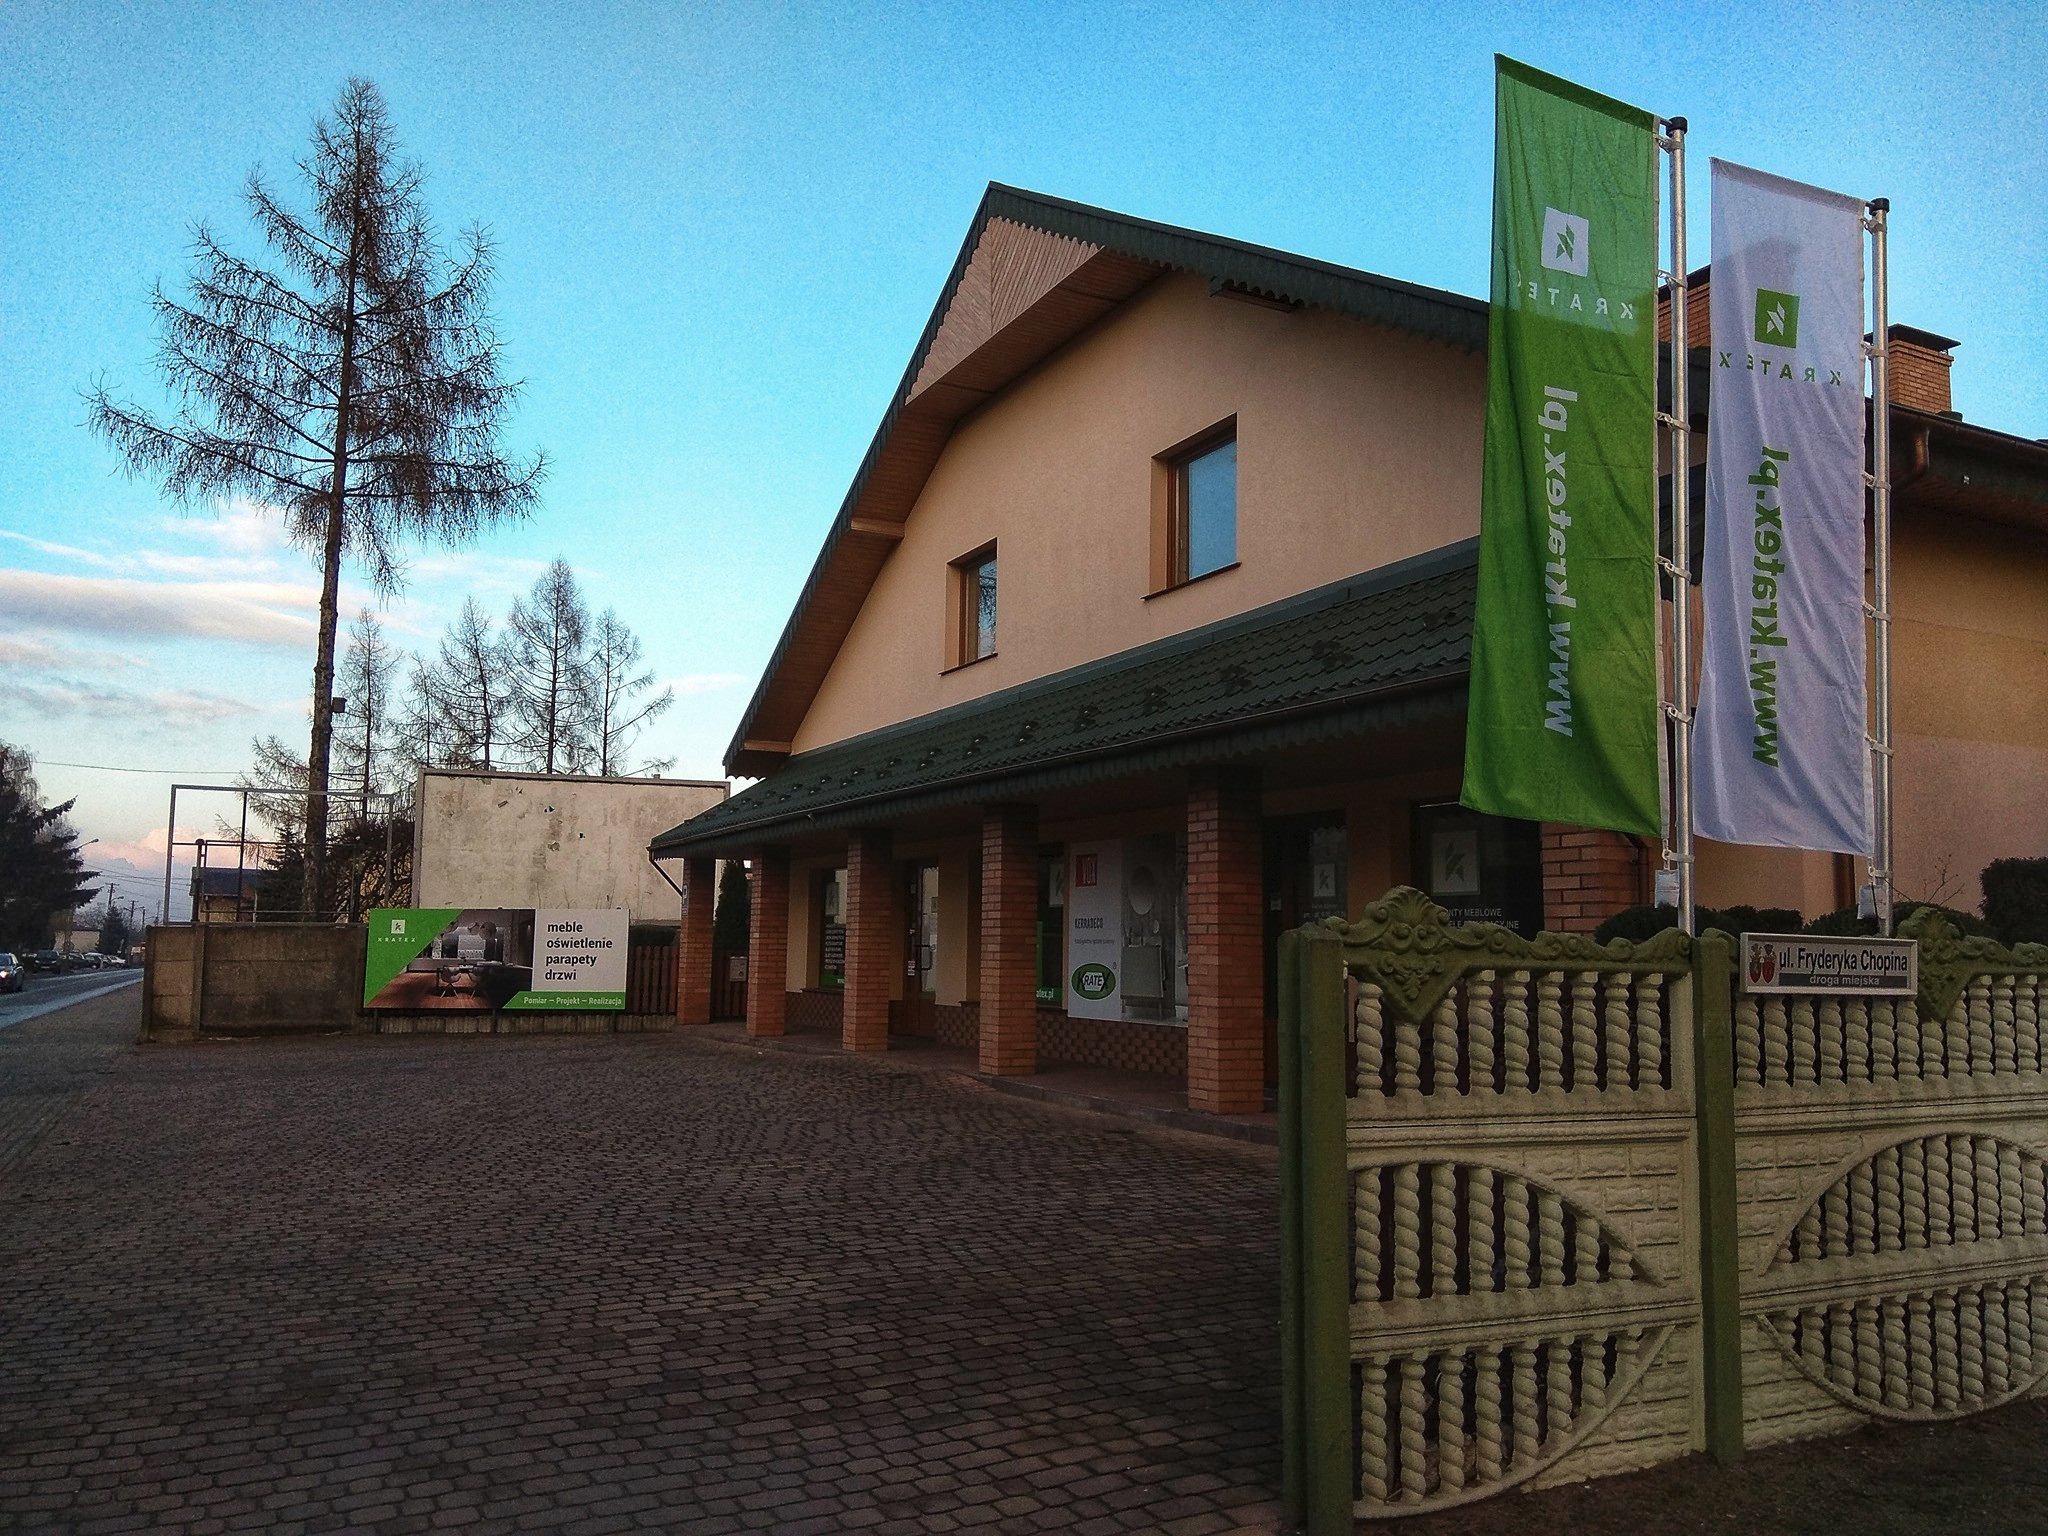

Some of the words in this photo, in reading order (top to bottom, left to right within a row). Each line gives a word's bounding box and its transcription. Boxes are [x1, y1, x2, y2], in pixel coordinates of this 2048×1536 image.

[1464, 908, 1502, 917] MEBLOWE
[547, 921, 583, 933] meble
[546, 937, 613, 949] oświetlenie
[545, 954, 597, 967] parapety
[1779, 947, 1794, 970] ul.
[1798, 947, 1858, 975] Fryderyka
[1860, 949, 1908, 976] Chopina
[544, 969, 577, 981] drzwi
[1809, 976, 1839, 987] droga
[1842, 976, 1880, 988] miejska
[523, 996, 548, 1004] Pomiar
[555, 997, 580, 1006] Projekt
[588, 997, 622, 1006] Realizacja
